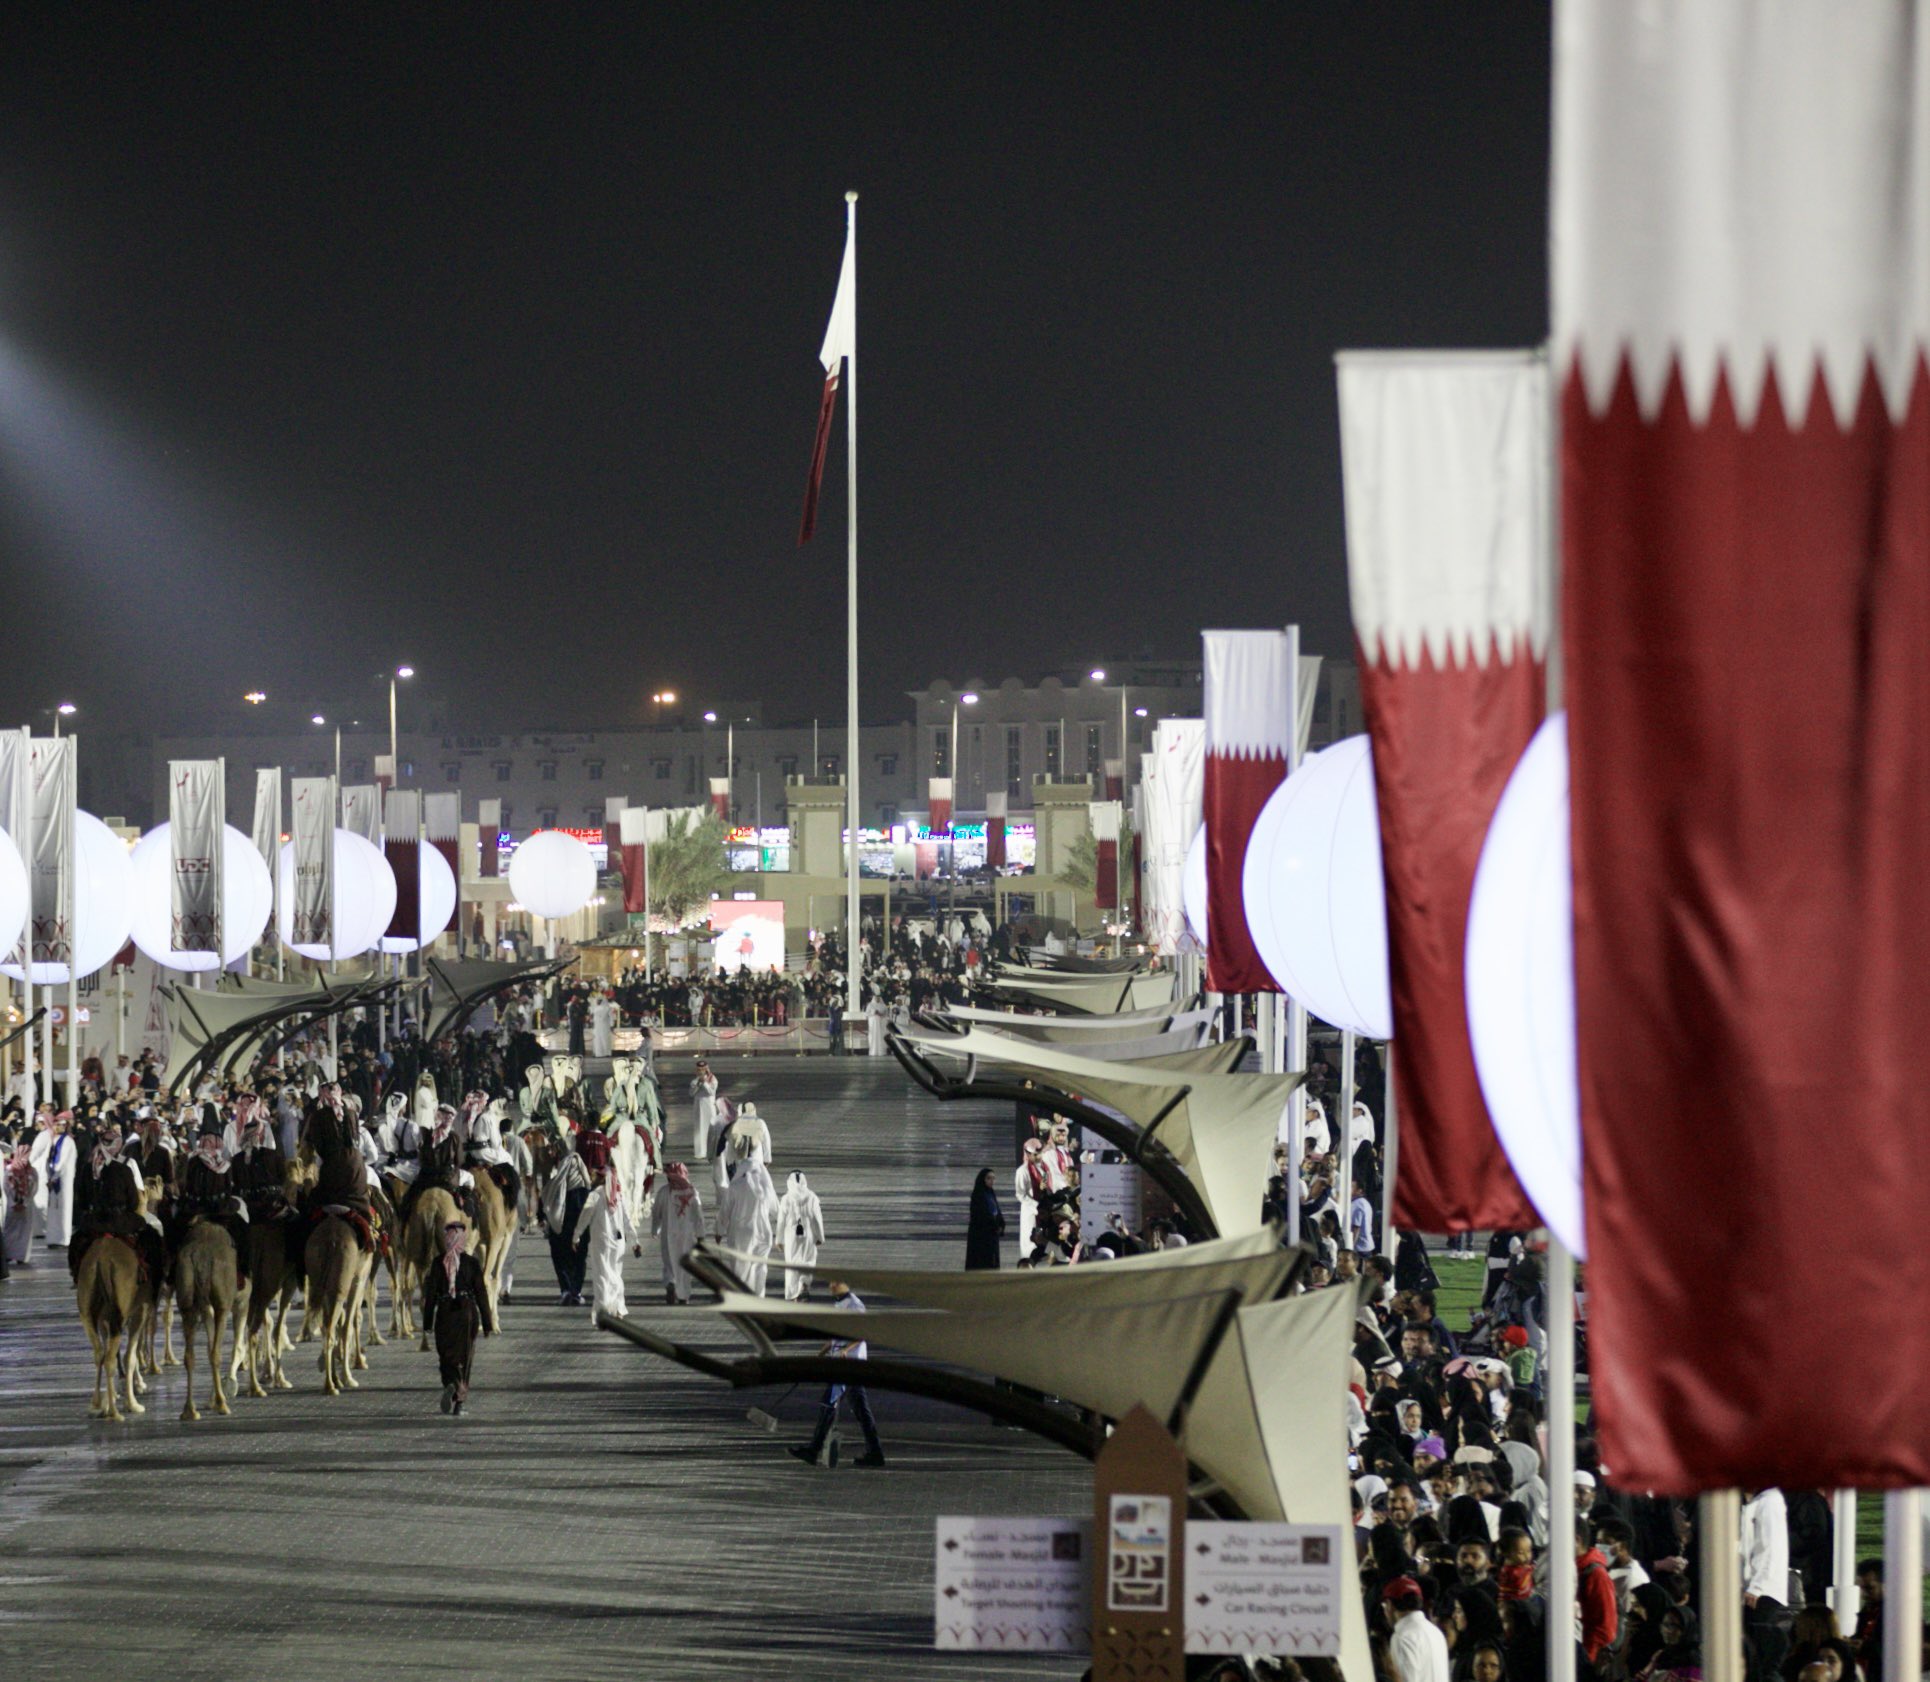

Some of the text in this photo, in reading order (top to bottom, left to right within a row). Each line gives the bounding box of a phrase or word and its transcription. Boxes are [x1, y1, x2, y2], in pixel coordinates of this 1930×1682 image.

[176, 859, 210, 872] UDC
[1258, 1554, 1298, 1567] Masjid
[1224, 1602, 1329, 1617] Car Racing Circuit
